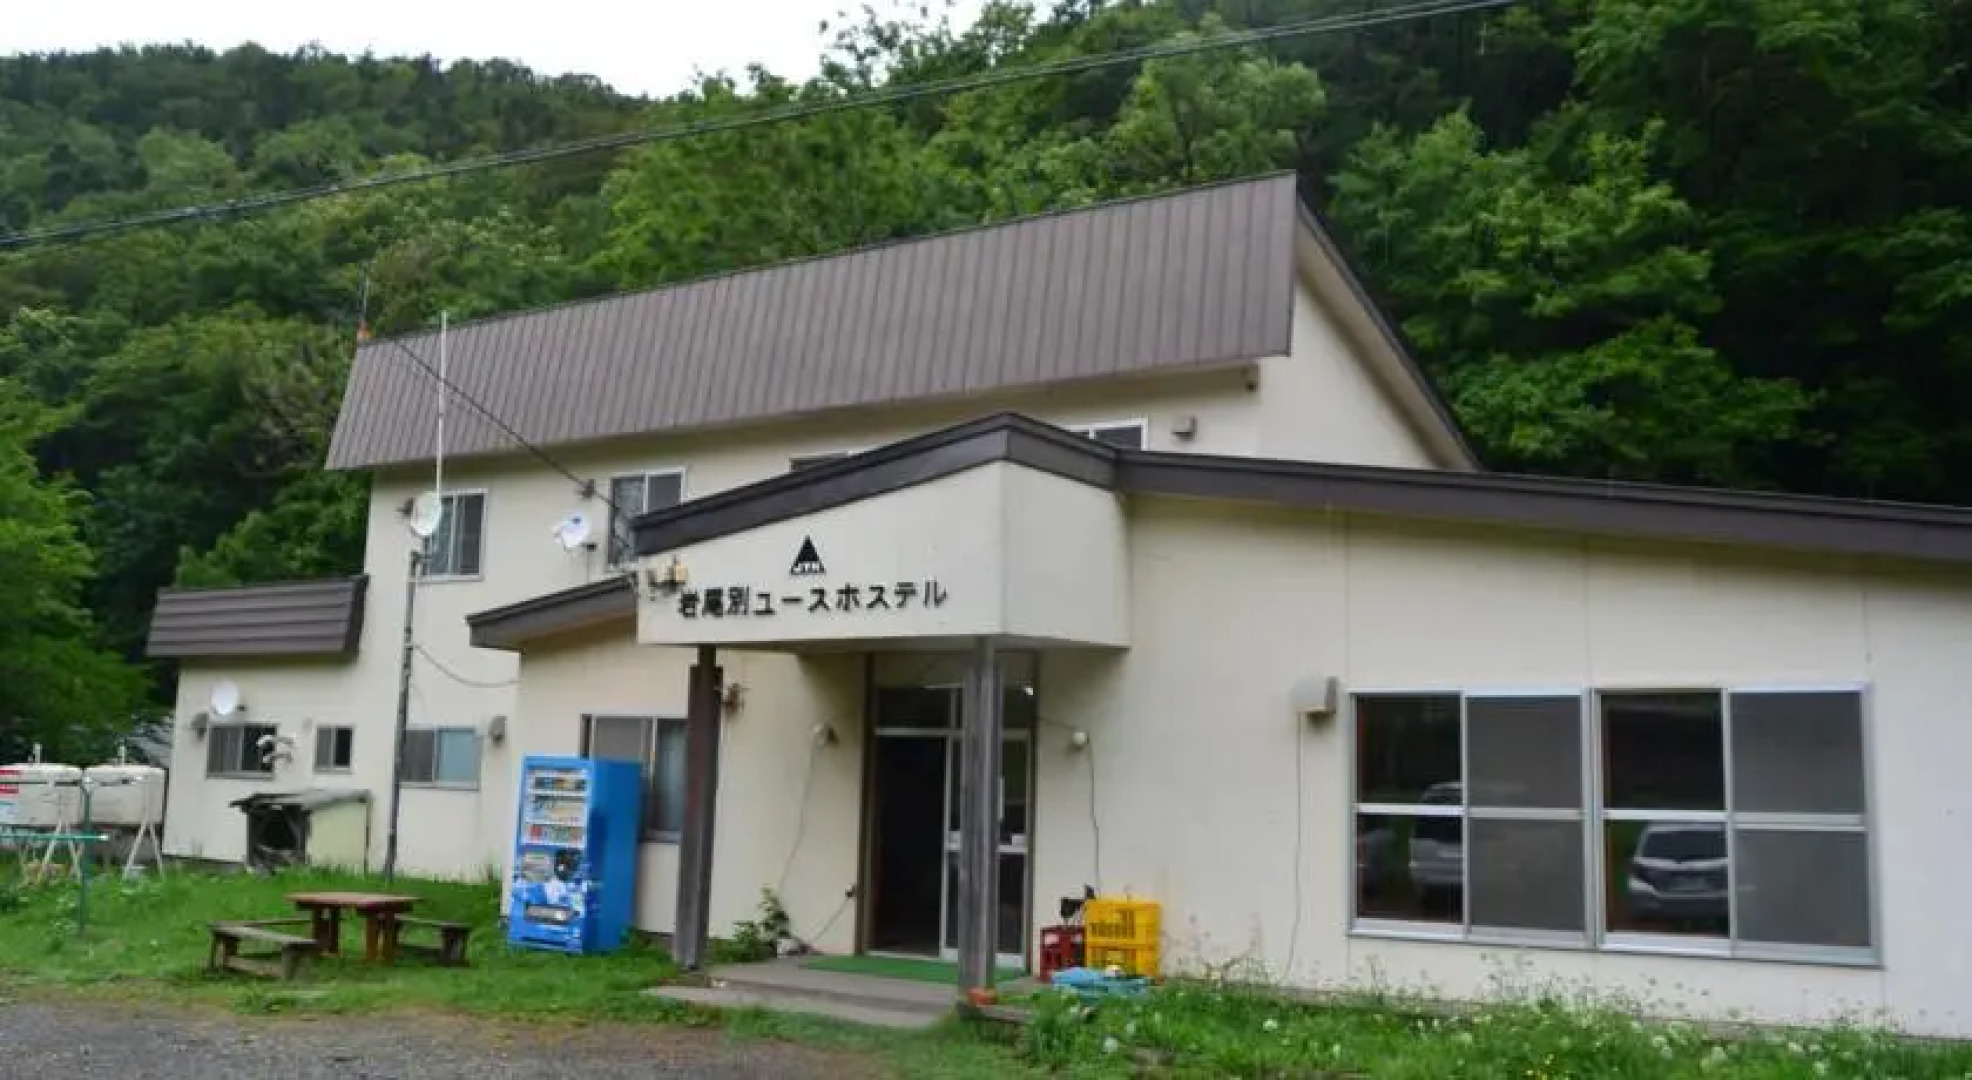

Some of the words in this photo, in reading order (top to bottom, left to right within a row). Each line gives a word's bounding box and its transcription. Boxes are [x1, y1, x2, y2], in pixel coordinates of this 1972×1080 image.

[678, 579, 948, 617] 岩尾別ユースホステル
